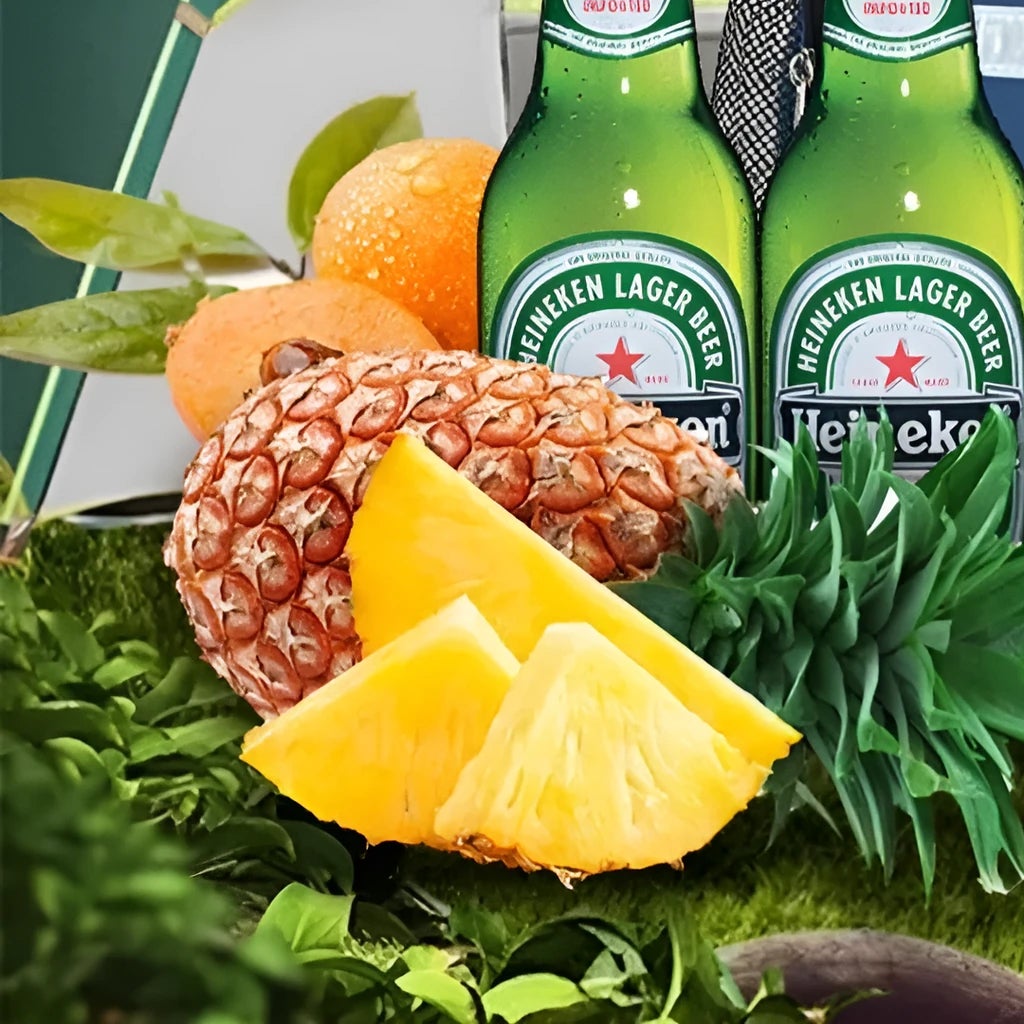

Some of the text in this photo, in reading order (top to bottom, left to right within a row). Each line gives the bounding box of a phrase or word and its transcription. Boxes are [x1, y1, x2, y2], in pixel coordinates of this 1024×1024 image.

[615, 273, 693, 316] LAGER
[688, 306, 724, 370] BEER
[797, 276, 884, 374] HEINEKEN
[895, 276, 973, 318] LAGER
[969, 309, 1004, 373] BEER
